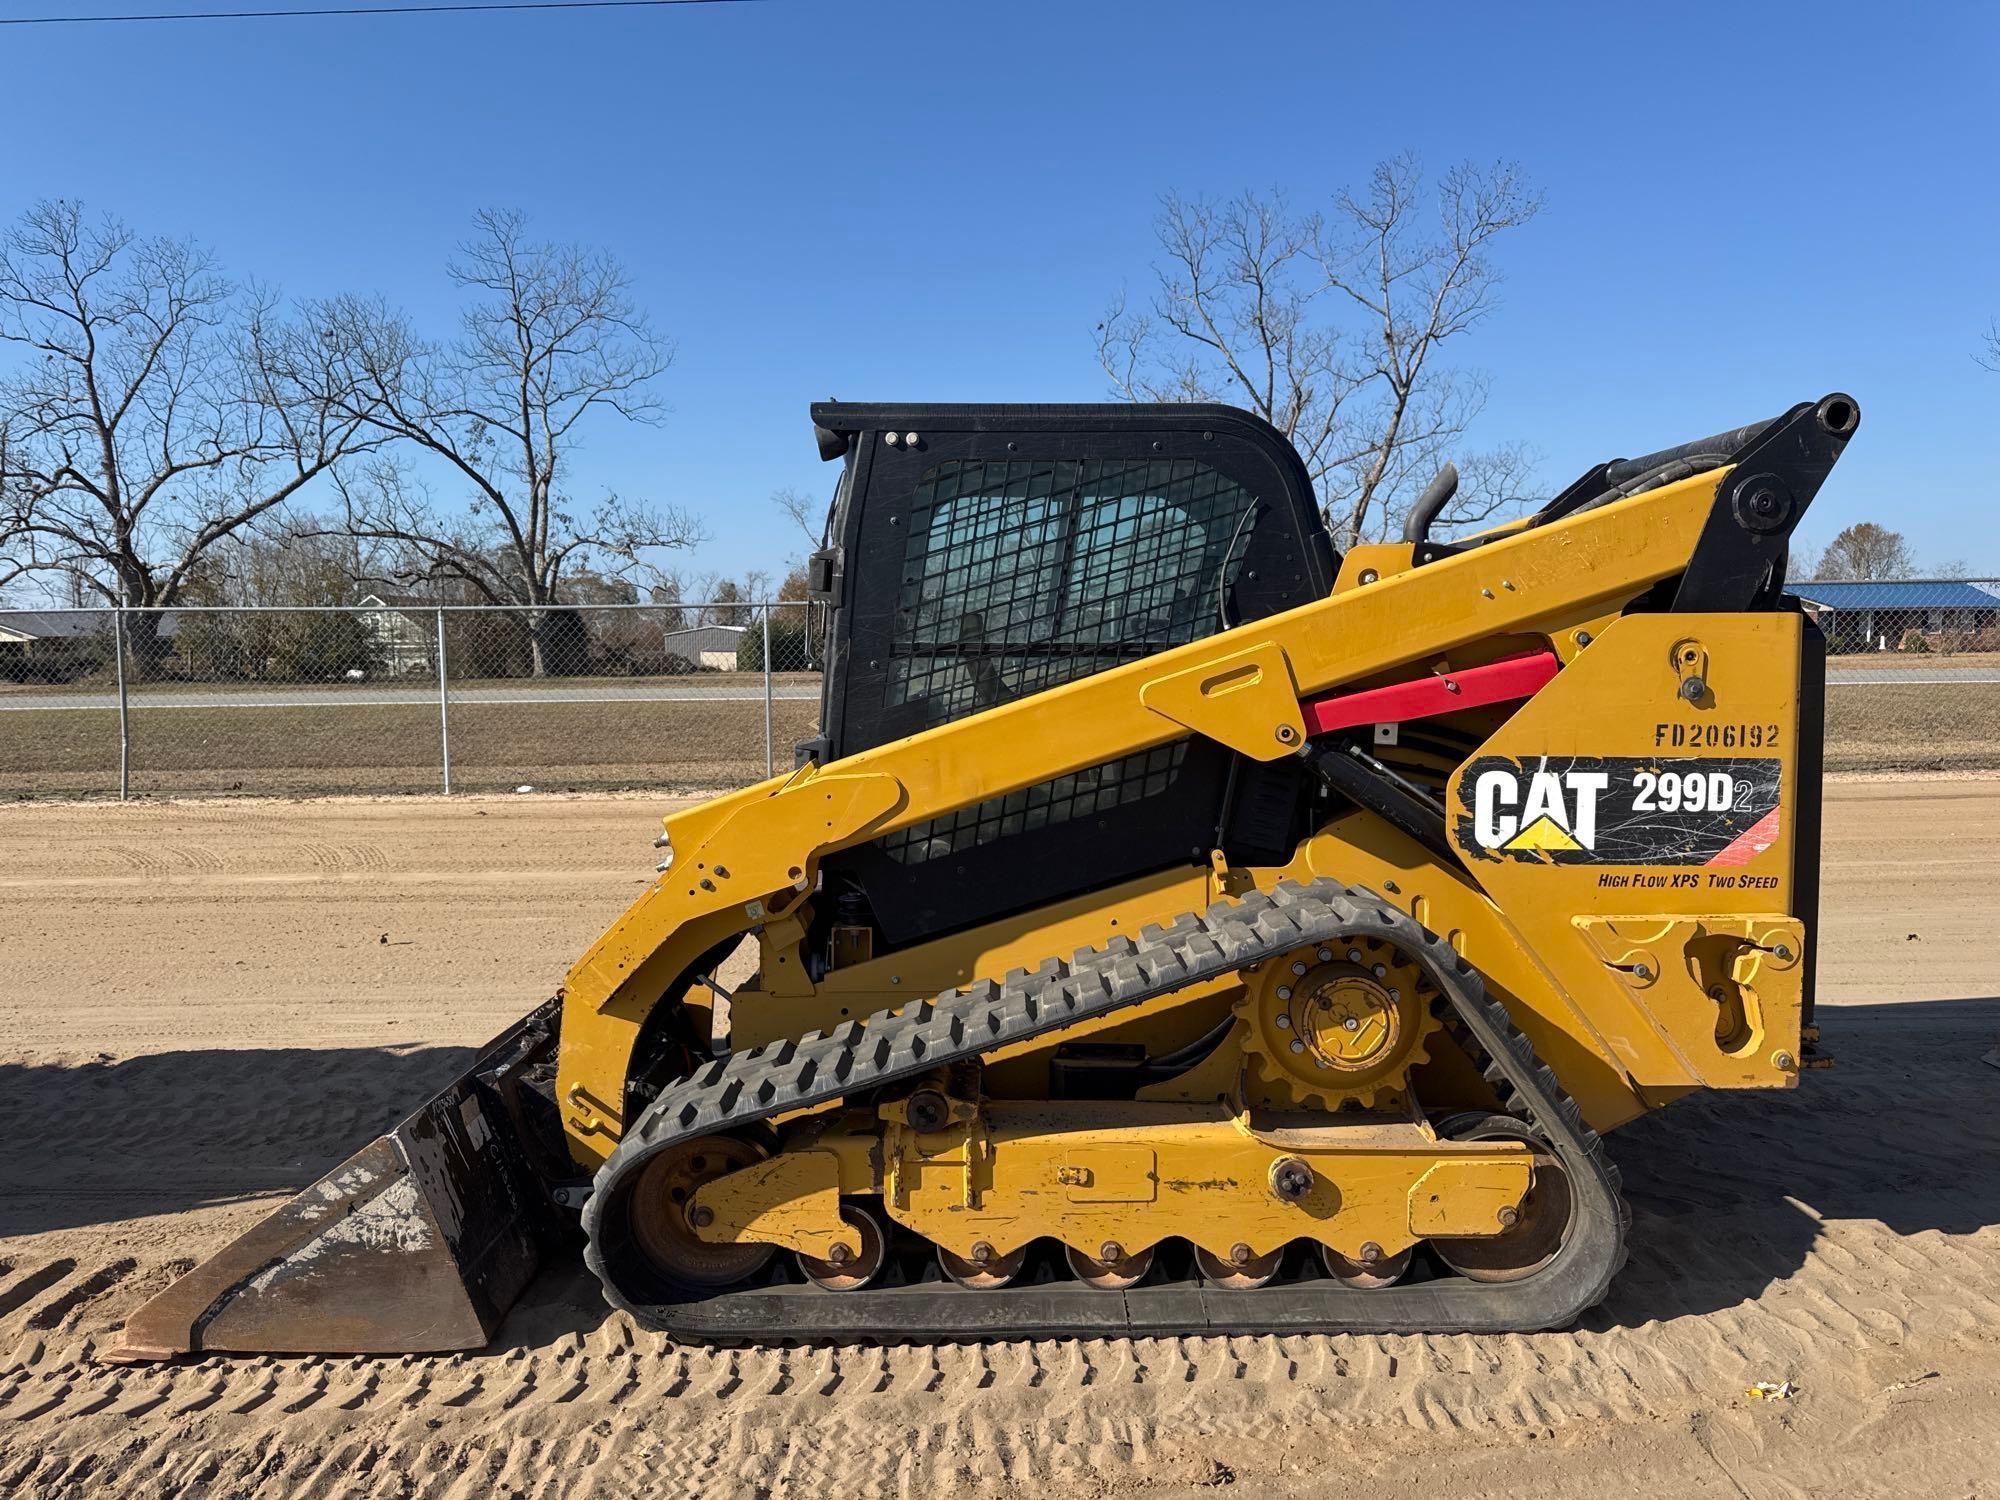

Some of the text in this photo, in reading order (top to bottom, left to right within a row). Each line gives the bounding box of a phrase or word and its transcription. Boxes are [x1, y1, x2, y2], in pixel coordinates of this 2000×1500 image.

[1656, 724, 1779, 747] FD206192
[1474, 770, 1608, 850] CAT
[1598, 873, 1778, 889] HIGH FLOW XPS TWO SPEED
